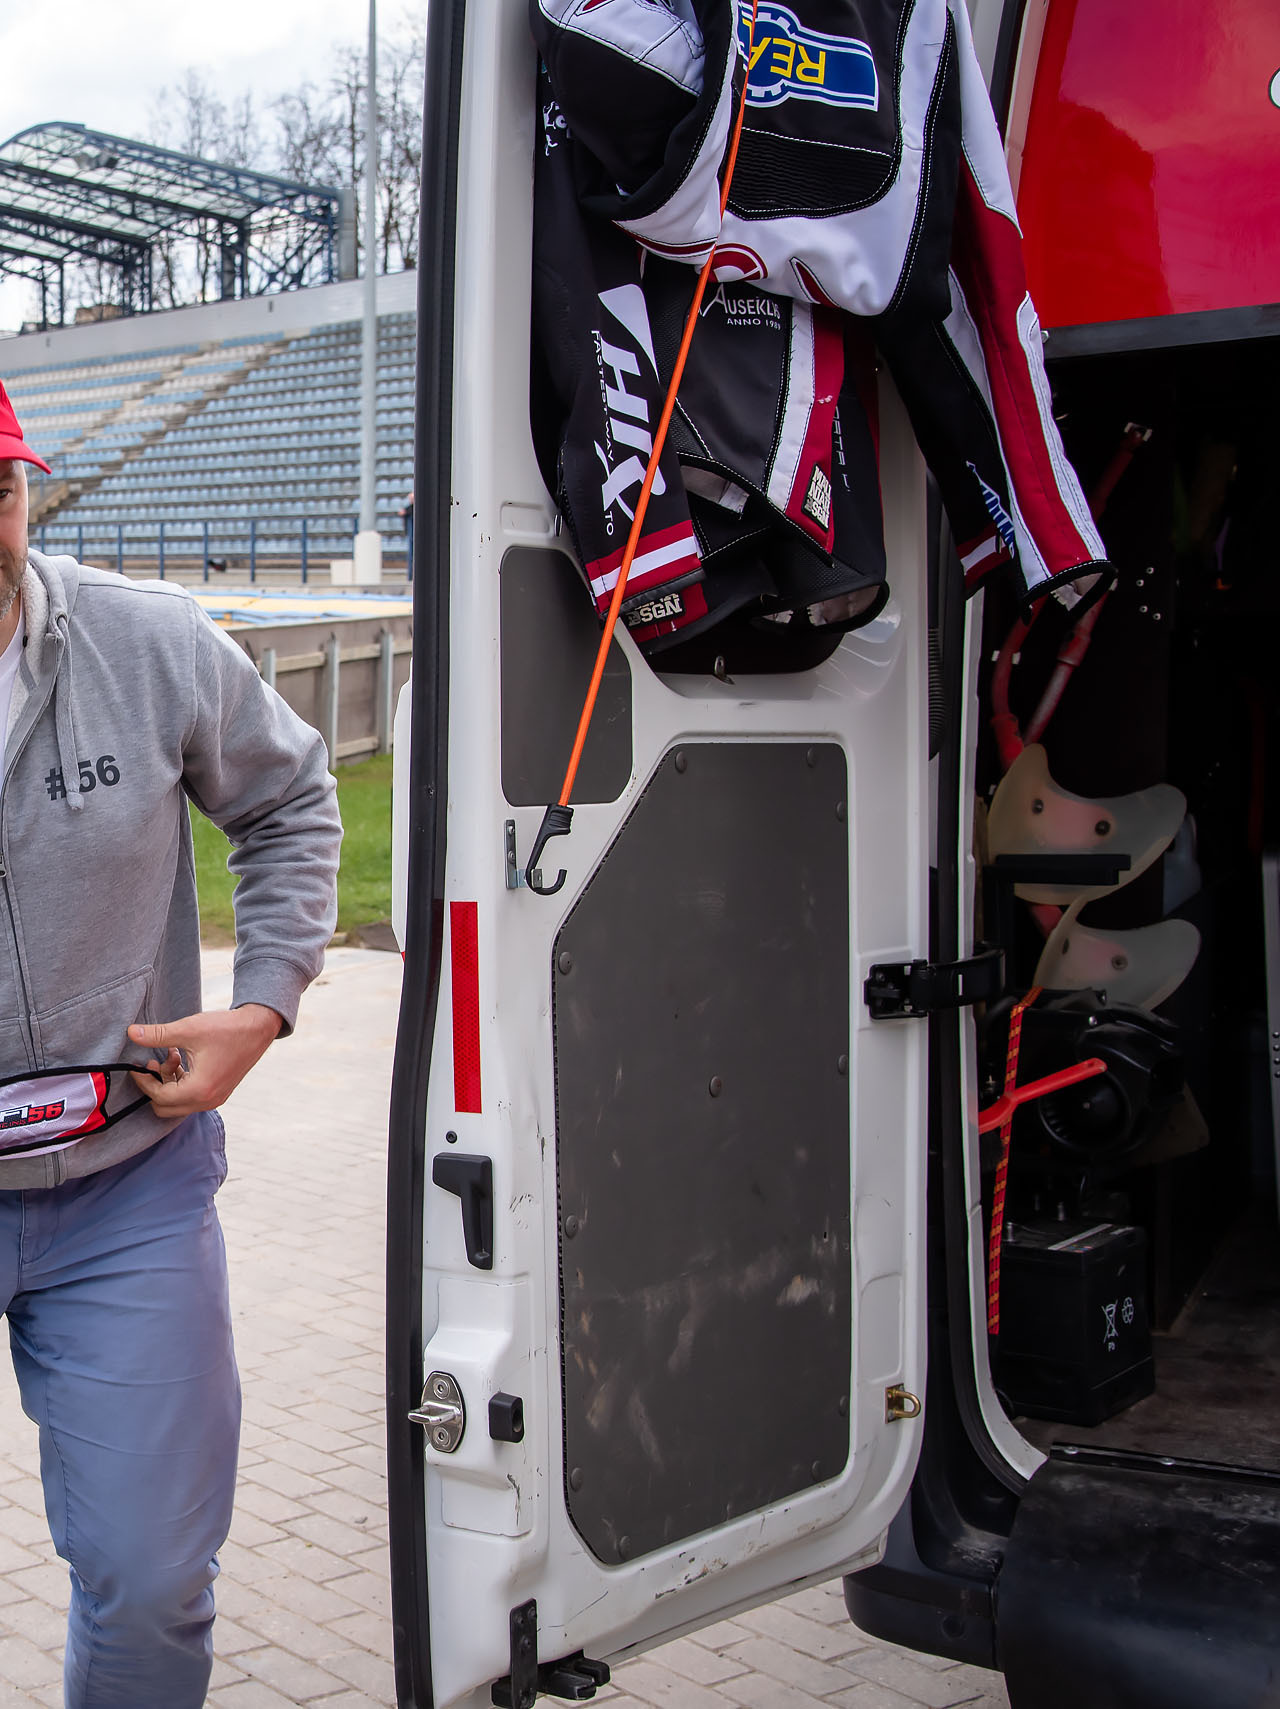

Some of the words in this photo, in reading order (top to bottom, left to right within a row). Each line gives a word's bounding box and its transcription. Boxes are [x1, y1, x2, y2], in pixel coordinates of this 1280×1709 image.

[726, 318, 762, 326] ANNO
[591, 330, 609, 416] FASTEST
[604, 420, 614, 462] WAY
[604, 510, 615, 536] TO
[44, 755, 121, 801] #56
